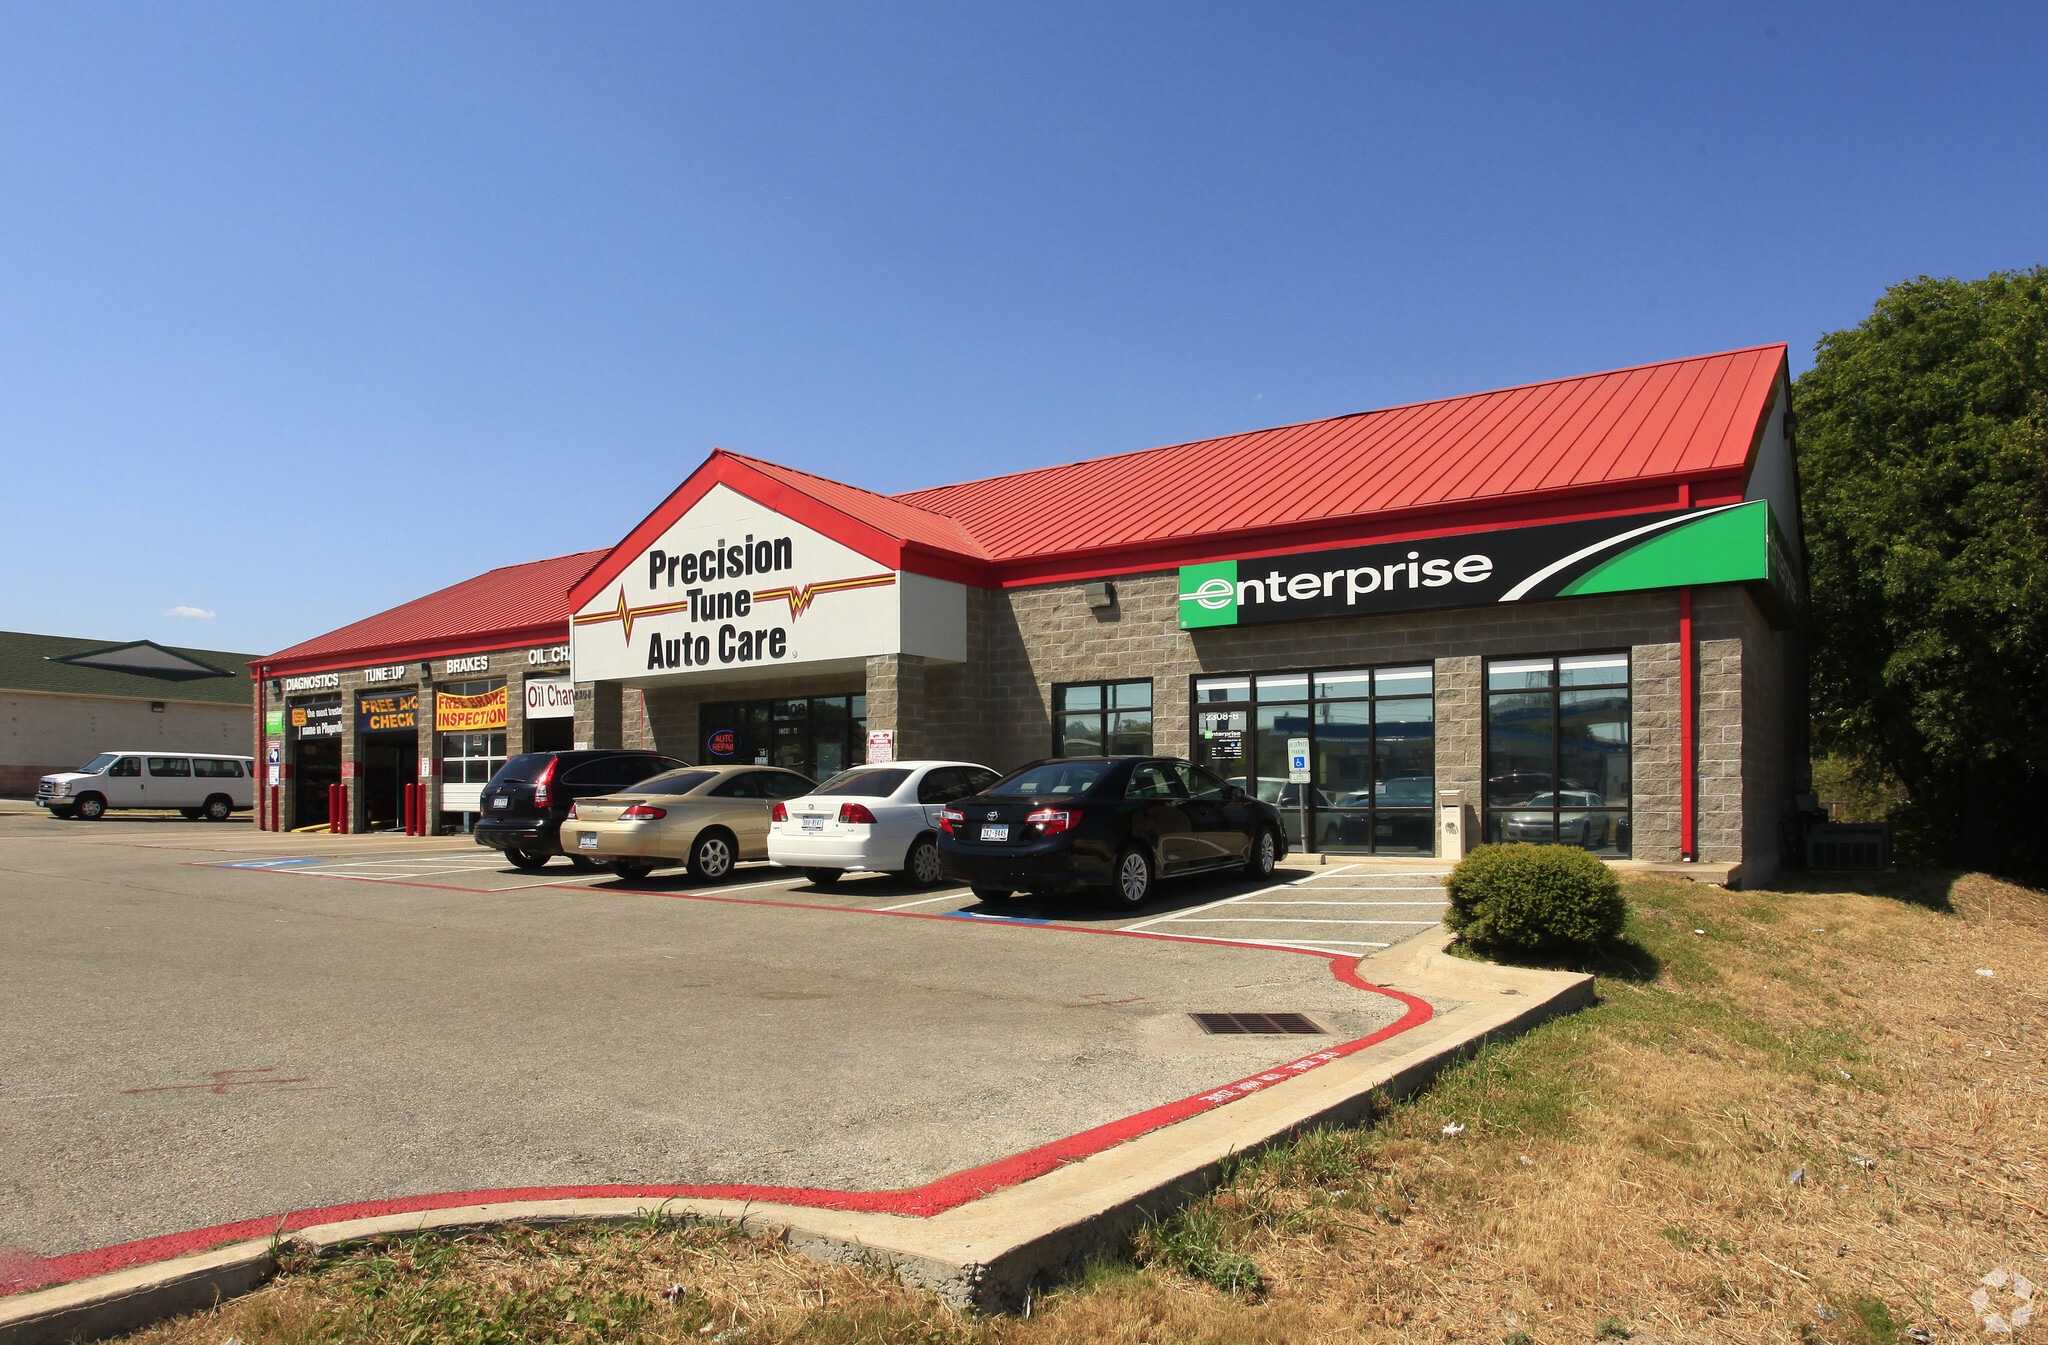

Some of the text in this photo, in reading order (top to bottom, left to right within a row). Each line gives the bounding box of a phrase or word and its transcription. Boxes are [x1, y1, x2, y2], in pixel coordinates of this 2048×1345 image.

[649, 533, 792, 590] Precision
[1179, 551, 1493, 610] enterprise
[687, 588, 751, 623] Tune
[528, 649, 546, 664] OIL
[647, 624, 787, 670] Auto Care
[446, 655, 488, 674] BRAKES
[286, 673, 339, 691] DIAGNOSTICS
[361, 695, 419, 714] FREE A/C
[438, 690, 506, 710] FREE BRAKE
[528, 685, 544, 708] Oil
[307, 708, 316, 718] the
[316, 708, 328, 717] most
[370, 712, 415, 730] CHECK
[438, 708, 506, 727] INSPECTION
[1205, 712, 1239, 721] 2308-B
[302, 726, 316, 736] name
[316, 722, 321, 735] in
